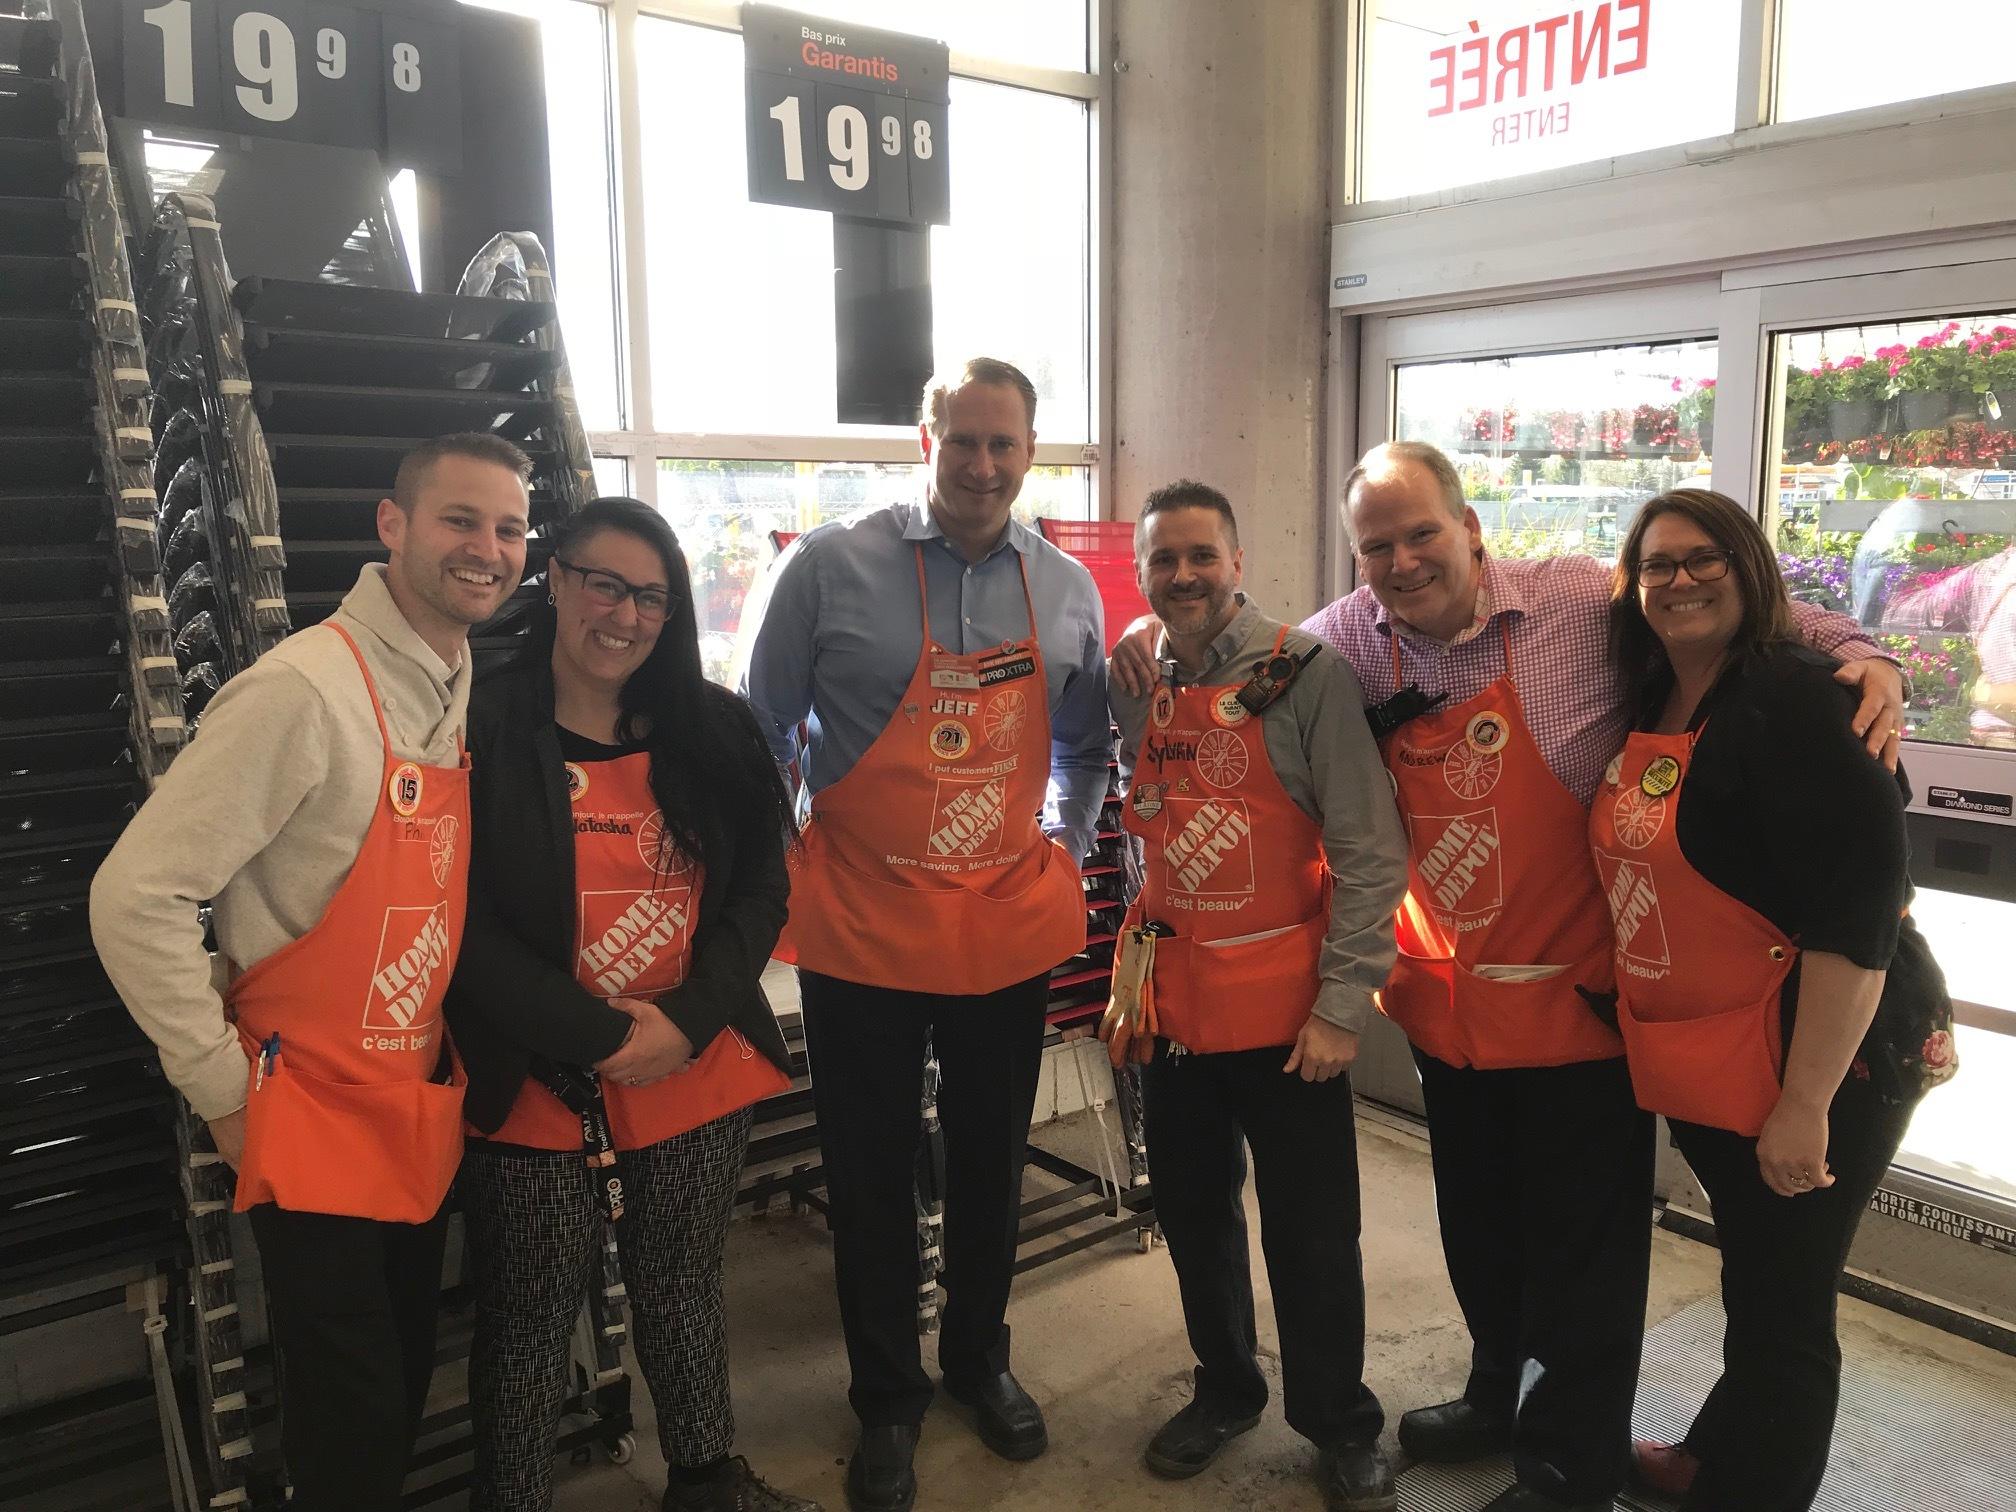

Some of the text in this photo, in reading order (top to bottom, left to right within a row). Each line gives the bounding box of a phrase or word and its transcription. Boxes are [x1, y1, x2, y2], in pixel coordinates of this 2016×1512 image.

[801, 26, 847, 46] Bas prix
[802, 43, 899, 81] Garantis
[1337, 276, 1365, 287] STANLEY
[931, 699, 978, 716] JEFF
[401, 778, 417, 801] 15
[935, 765, 950, 774] put
[952, 767, 993, 775] customers
[930, 779, 1005, 856] HOME
[942, 789, 975, 820] THE
[1945, 799, 2010, 814] DIAMOND SERIES
[960, 806, 1004, 856] DEPOT
[1164, 800, 1228, 870] HOME
[1177, 810, 1250, 893] DEPOT
[886, 854, 918, 866] More
[920, 859, 962, 873] saving.
[968, 858, 993, 871] More
[1418, 816, 1478, 888] HOME
[1435, 824, 1499, 910] DEPOT
[1165, 895, 1193, 911] c'est
[1616, 876, 1658, 952] DEPOT
[580, 890, 668, 974] HOME
[595, 902, 687, 996] DEPOT
[373, 912, 438, 1001] HOME
[386, 918, 449, 1029] DEPOT
[362, 1034, 407, 1051] c'est
[606, 1177, 625, 1208] PRO
[1870, 1200, 1972, 1241] AUTOMATIQUE
[1871, 1190, 2016, 1246] PORTE COULISSANT
